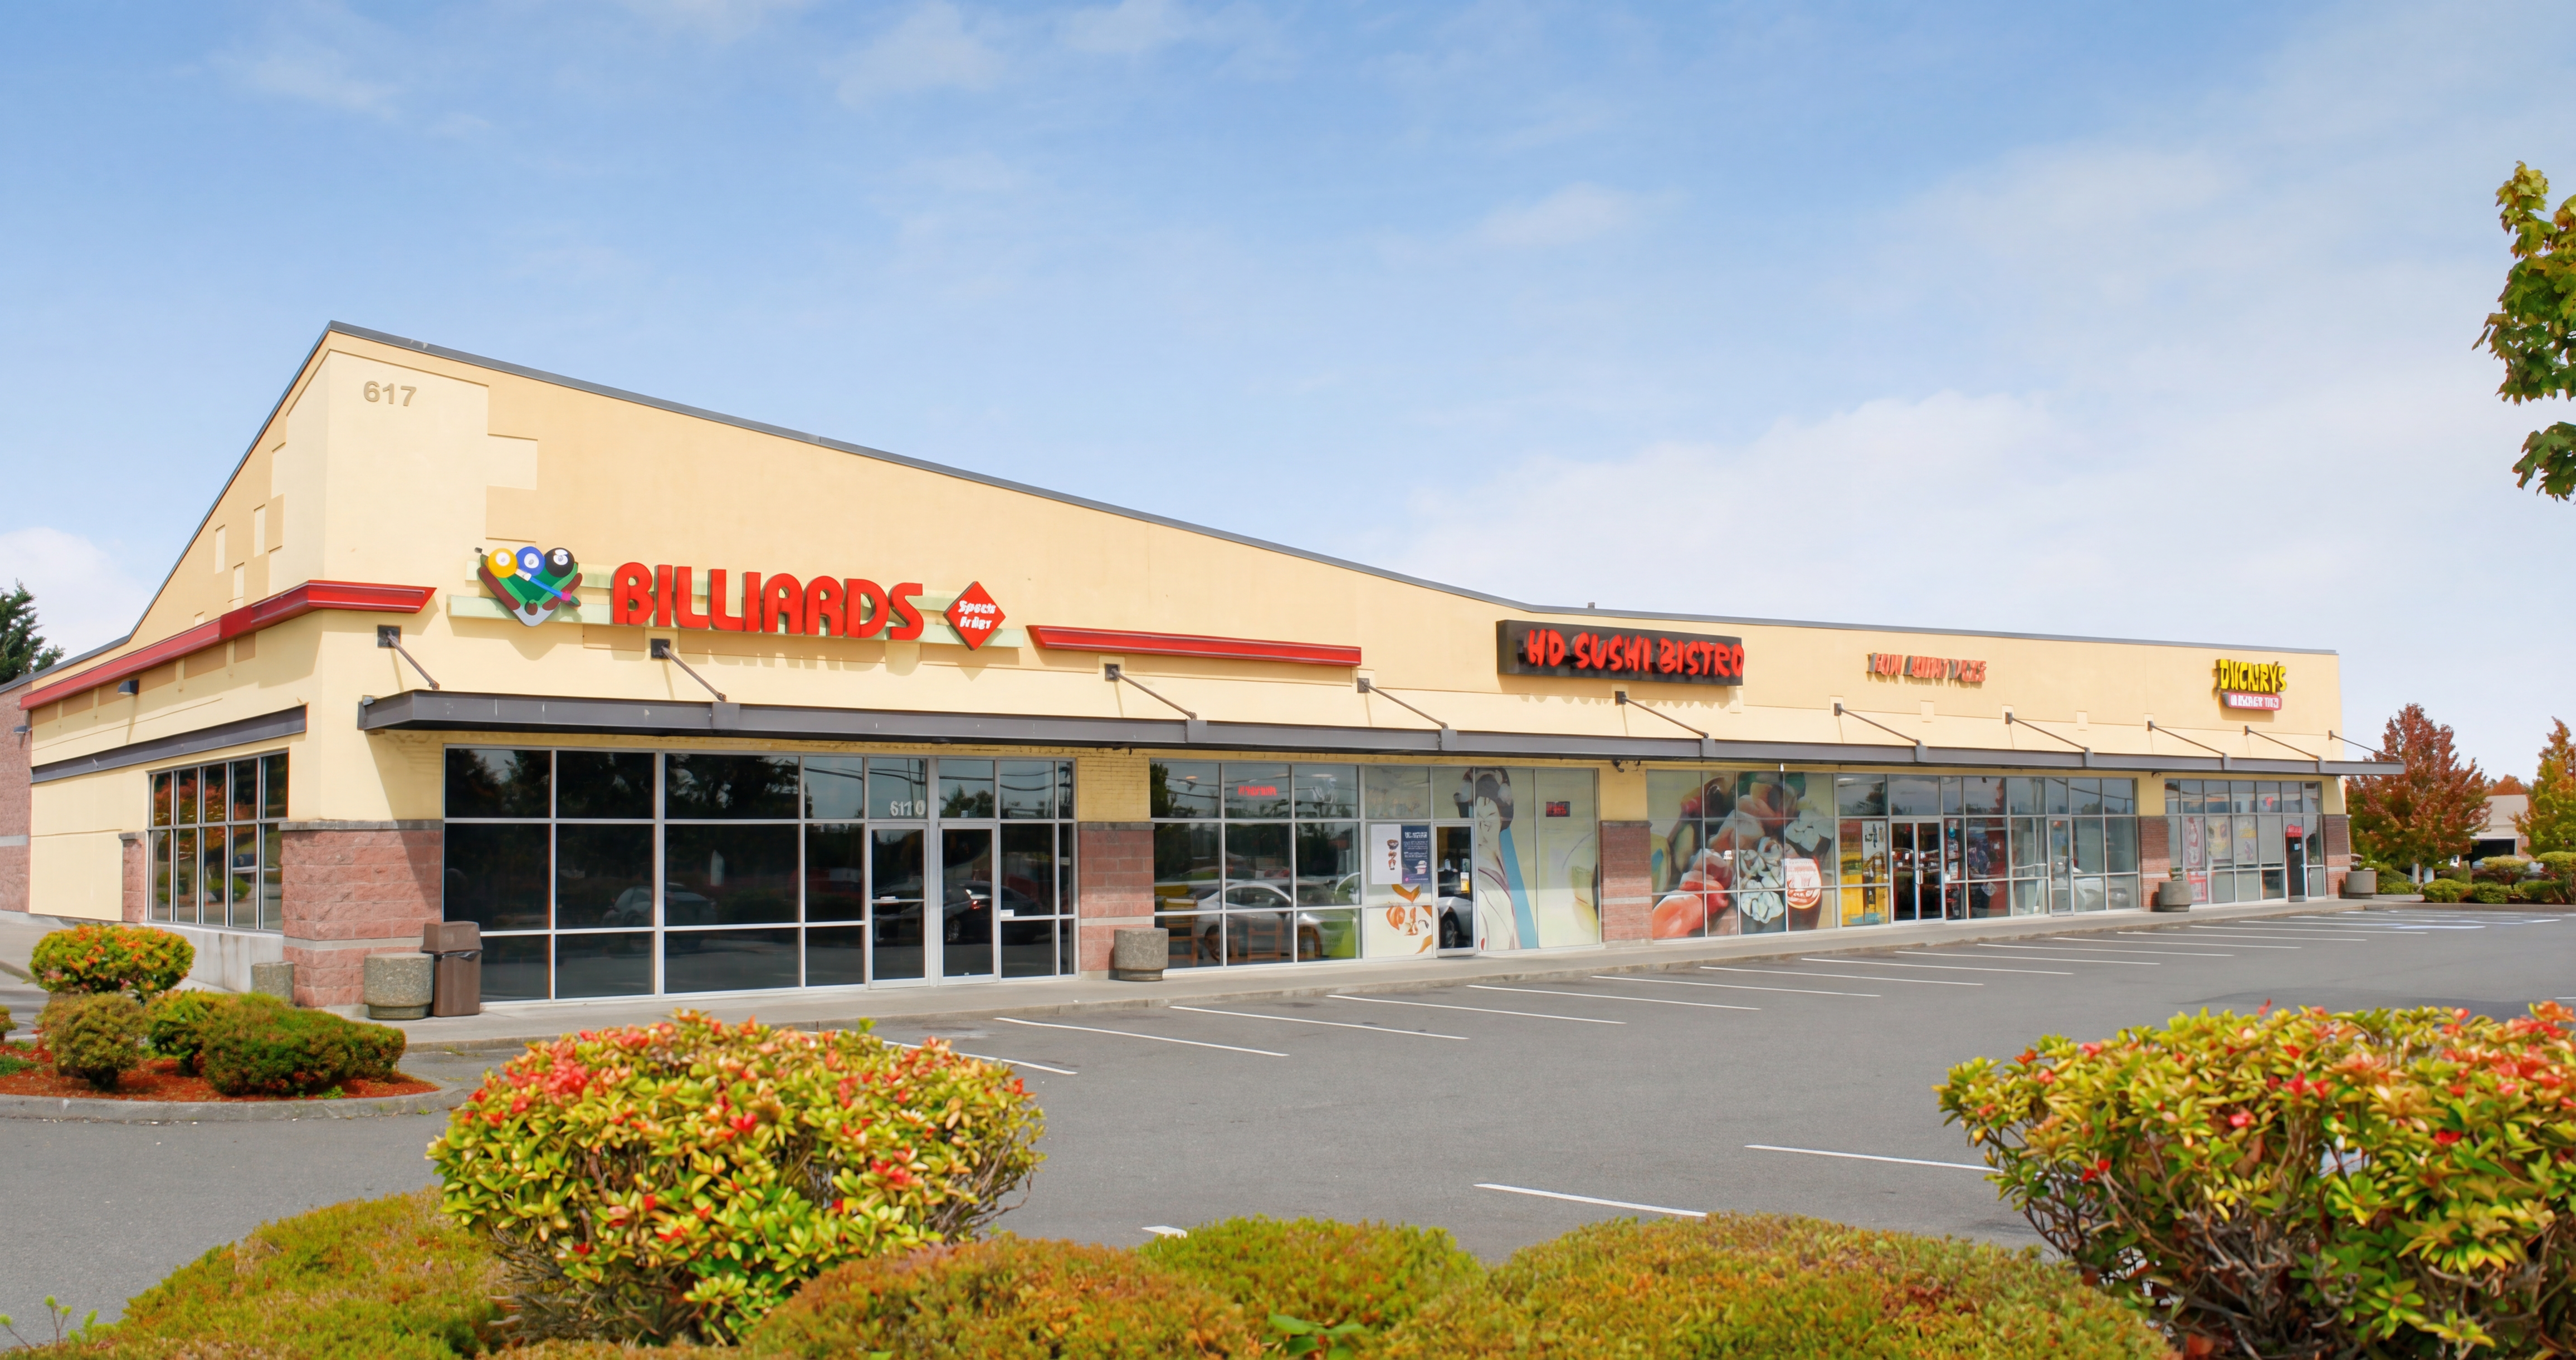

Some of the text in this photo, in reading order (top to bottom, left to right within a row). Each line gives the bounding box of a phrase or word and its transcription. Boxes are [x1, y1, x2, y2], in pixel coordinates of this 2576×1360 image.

[364, 381, 417, 406] 617
[611, 562, 924, 641] BILLIARDS
[1525, 629, 1744, 677] HD SUSHI BISTRO
